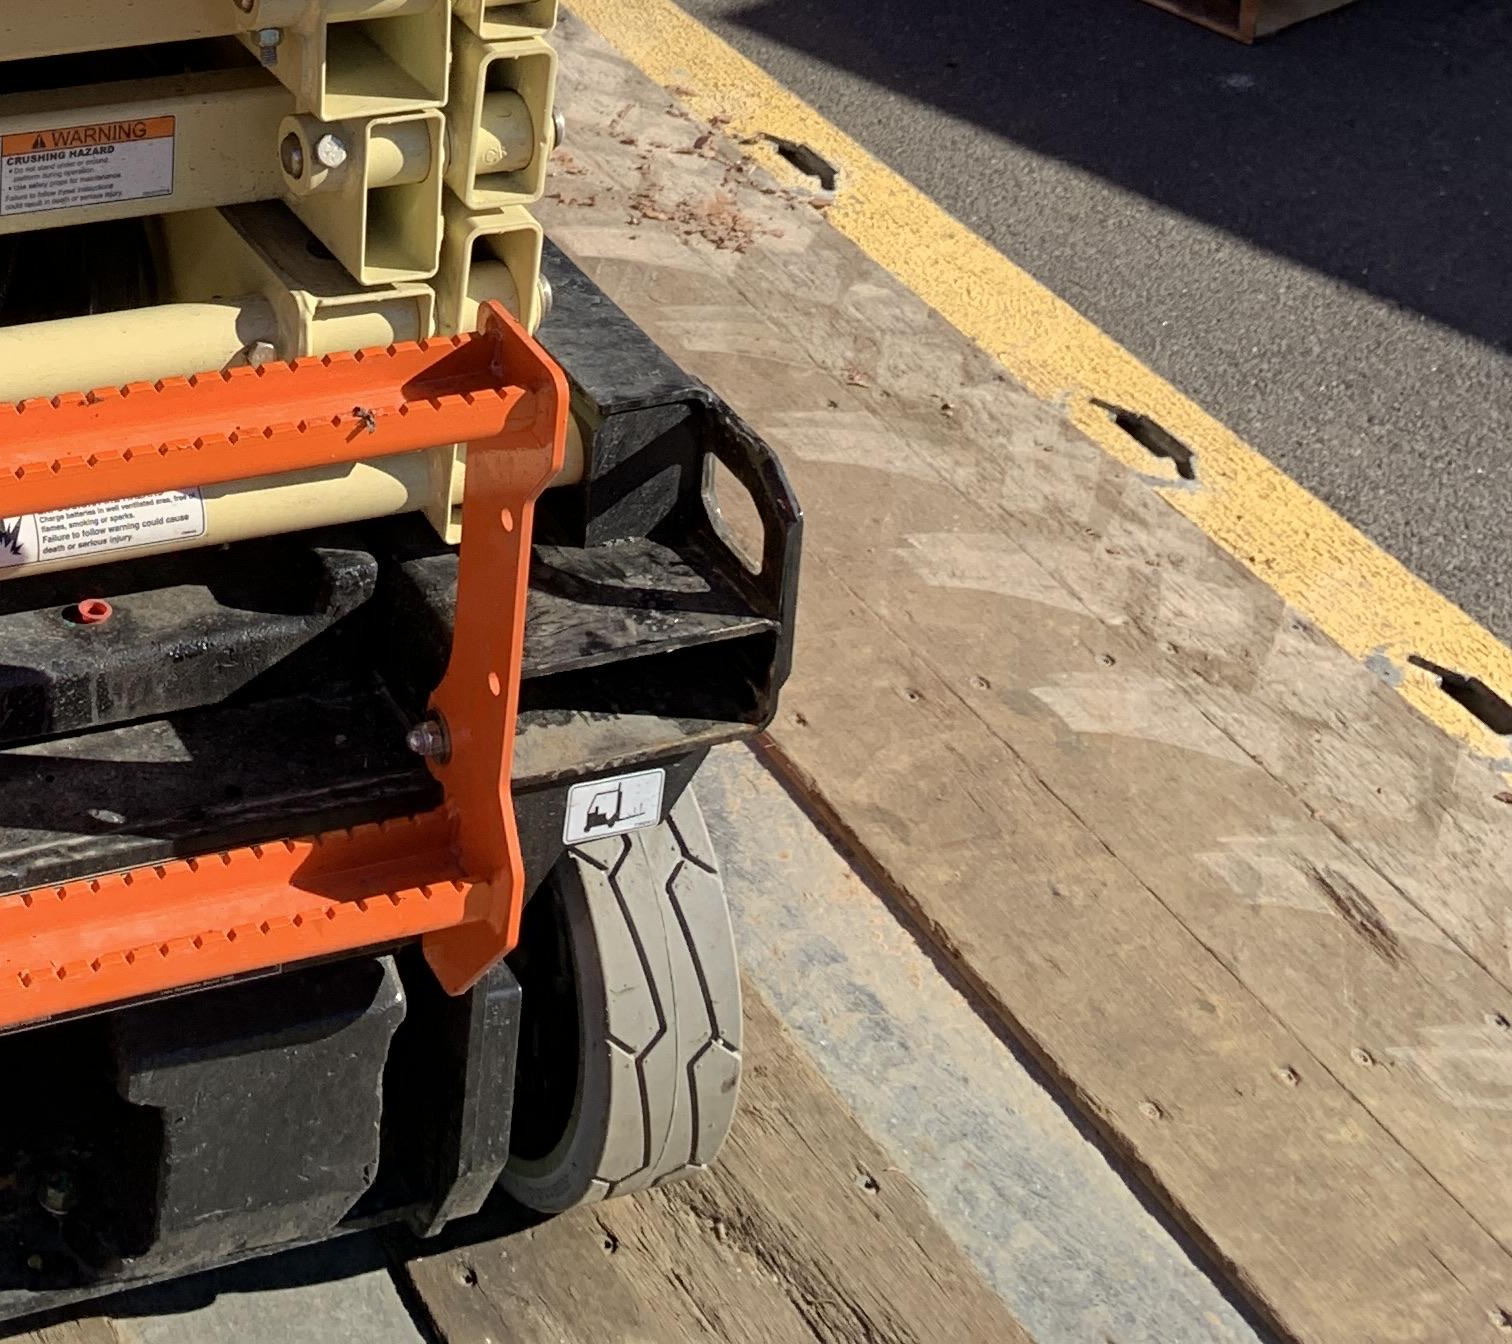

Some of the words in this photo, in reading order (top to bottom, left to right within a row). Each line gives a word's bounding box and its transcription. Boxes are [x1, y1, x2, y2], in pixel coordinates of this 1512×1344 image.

[52, 121, 147, 147] WARNING
[6, 151, 66, 165] CRUSHING
[69, 145, 115, 158] HAZARD
[40, 515, 65, 523] Charge
[66, 510, 96, 519] batteries
[121, 499, 154, 509] ventilated
[42, 534, 70, 543] Failure
[72, 531, 80, 539] to
[82, 528, 106, 537] follow
[108, 522, 140, 532] warning
[142, 517, 164, 527] could
[166, 514, 190, 523] cause
[69, 518, 99, 528] smoking
[43, 545, 65, 554] death
[78, 538, 107, 548] serious
